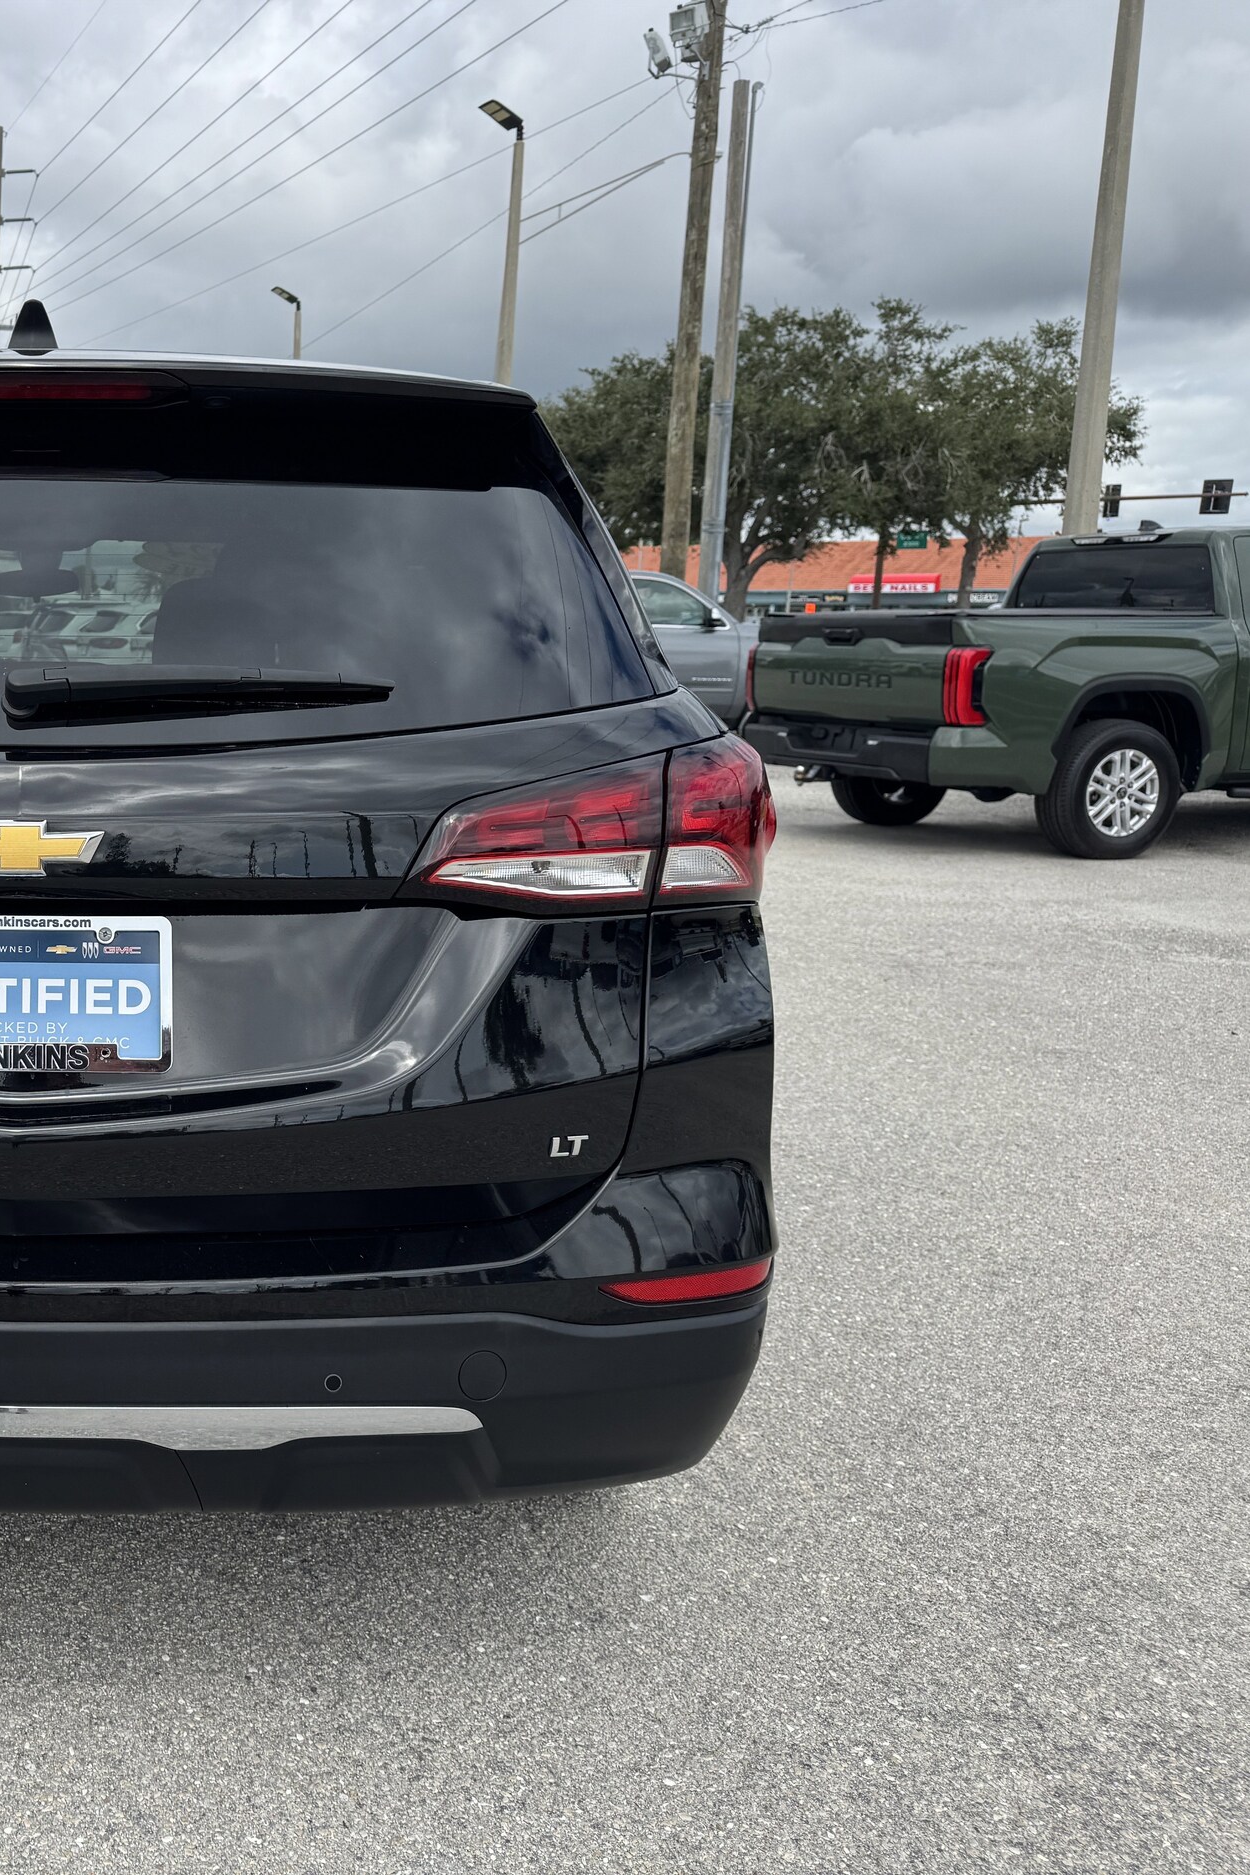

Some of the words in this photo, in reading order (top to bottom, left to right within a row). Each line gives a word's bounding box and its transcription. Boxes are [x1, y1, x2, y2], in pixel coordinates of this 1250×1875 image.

[788, 670, 893, 688] TUNDRA
[103, 946, 141, 954] GMC
[47, 1022, 68, 1033] BY
[550, 1135, 589, 1157] LT
